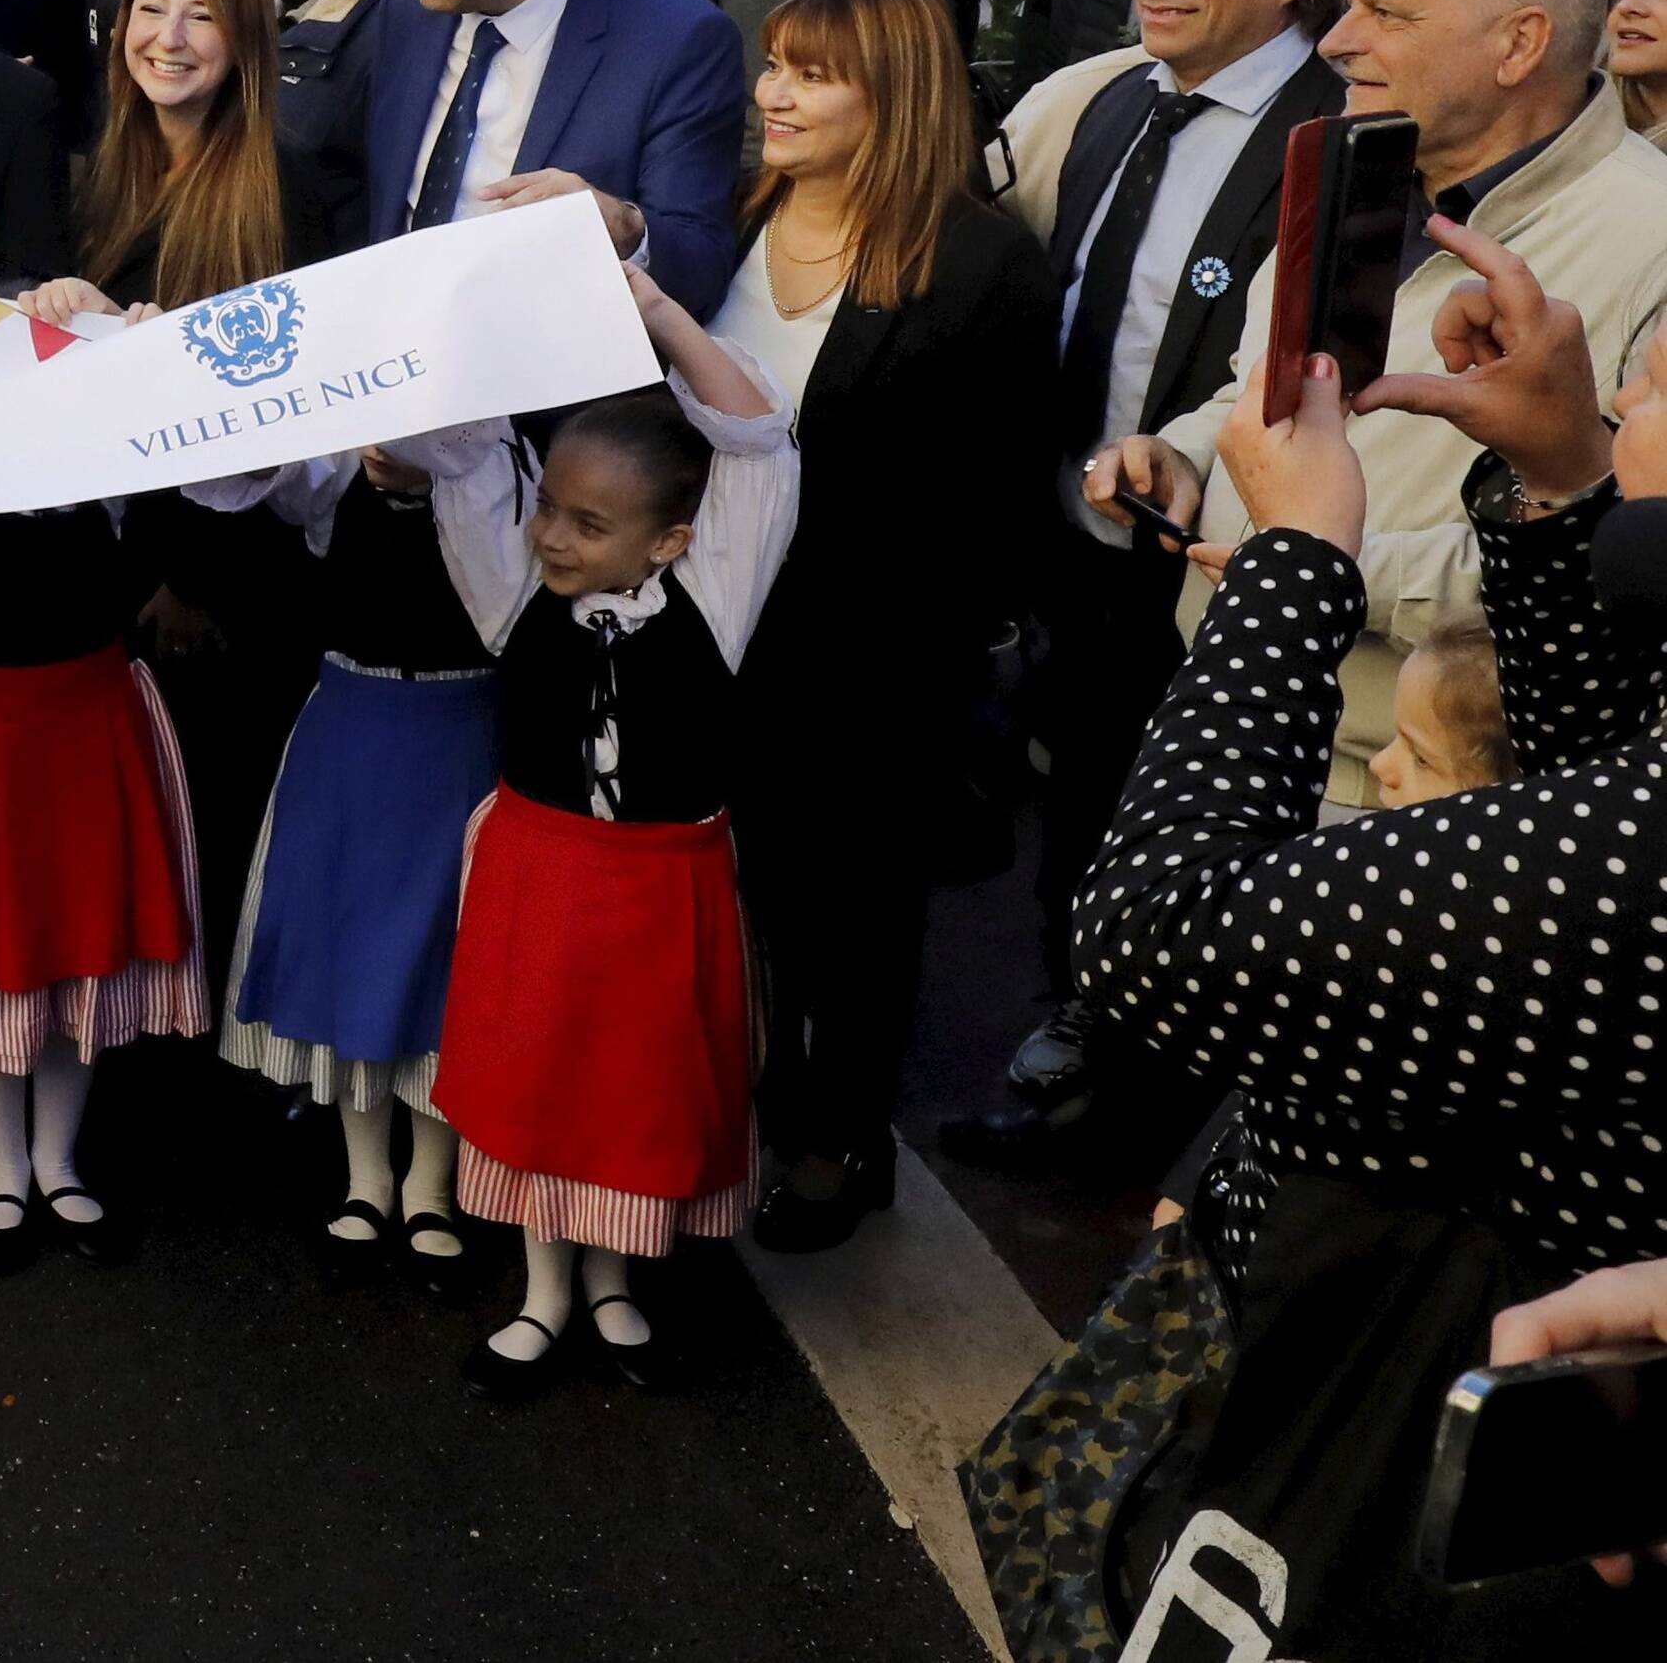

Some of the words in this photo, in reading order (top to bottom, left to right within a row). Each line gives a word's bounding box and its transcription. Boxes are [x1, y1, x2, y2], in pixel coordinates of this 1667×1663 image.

[128, 408, 243, 459] VILLE
[248, 387, 312, 427] DE
[319, 348, 427, 408] NICE
